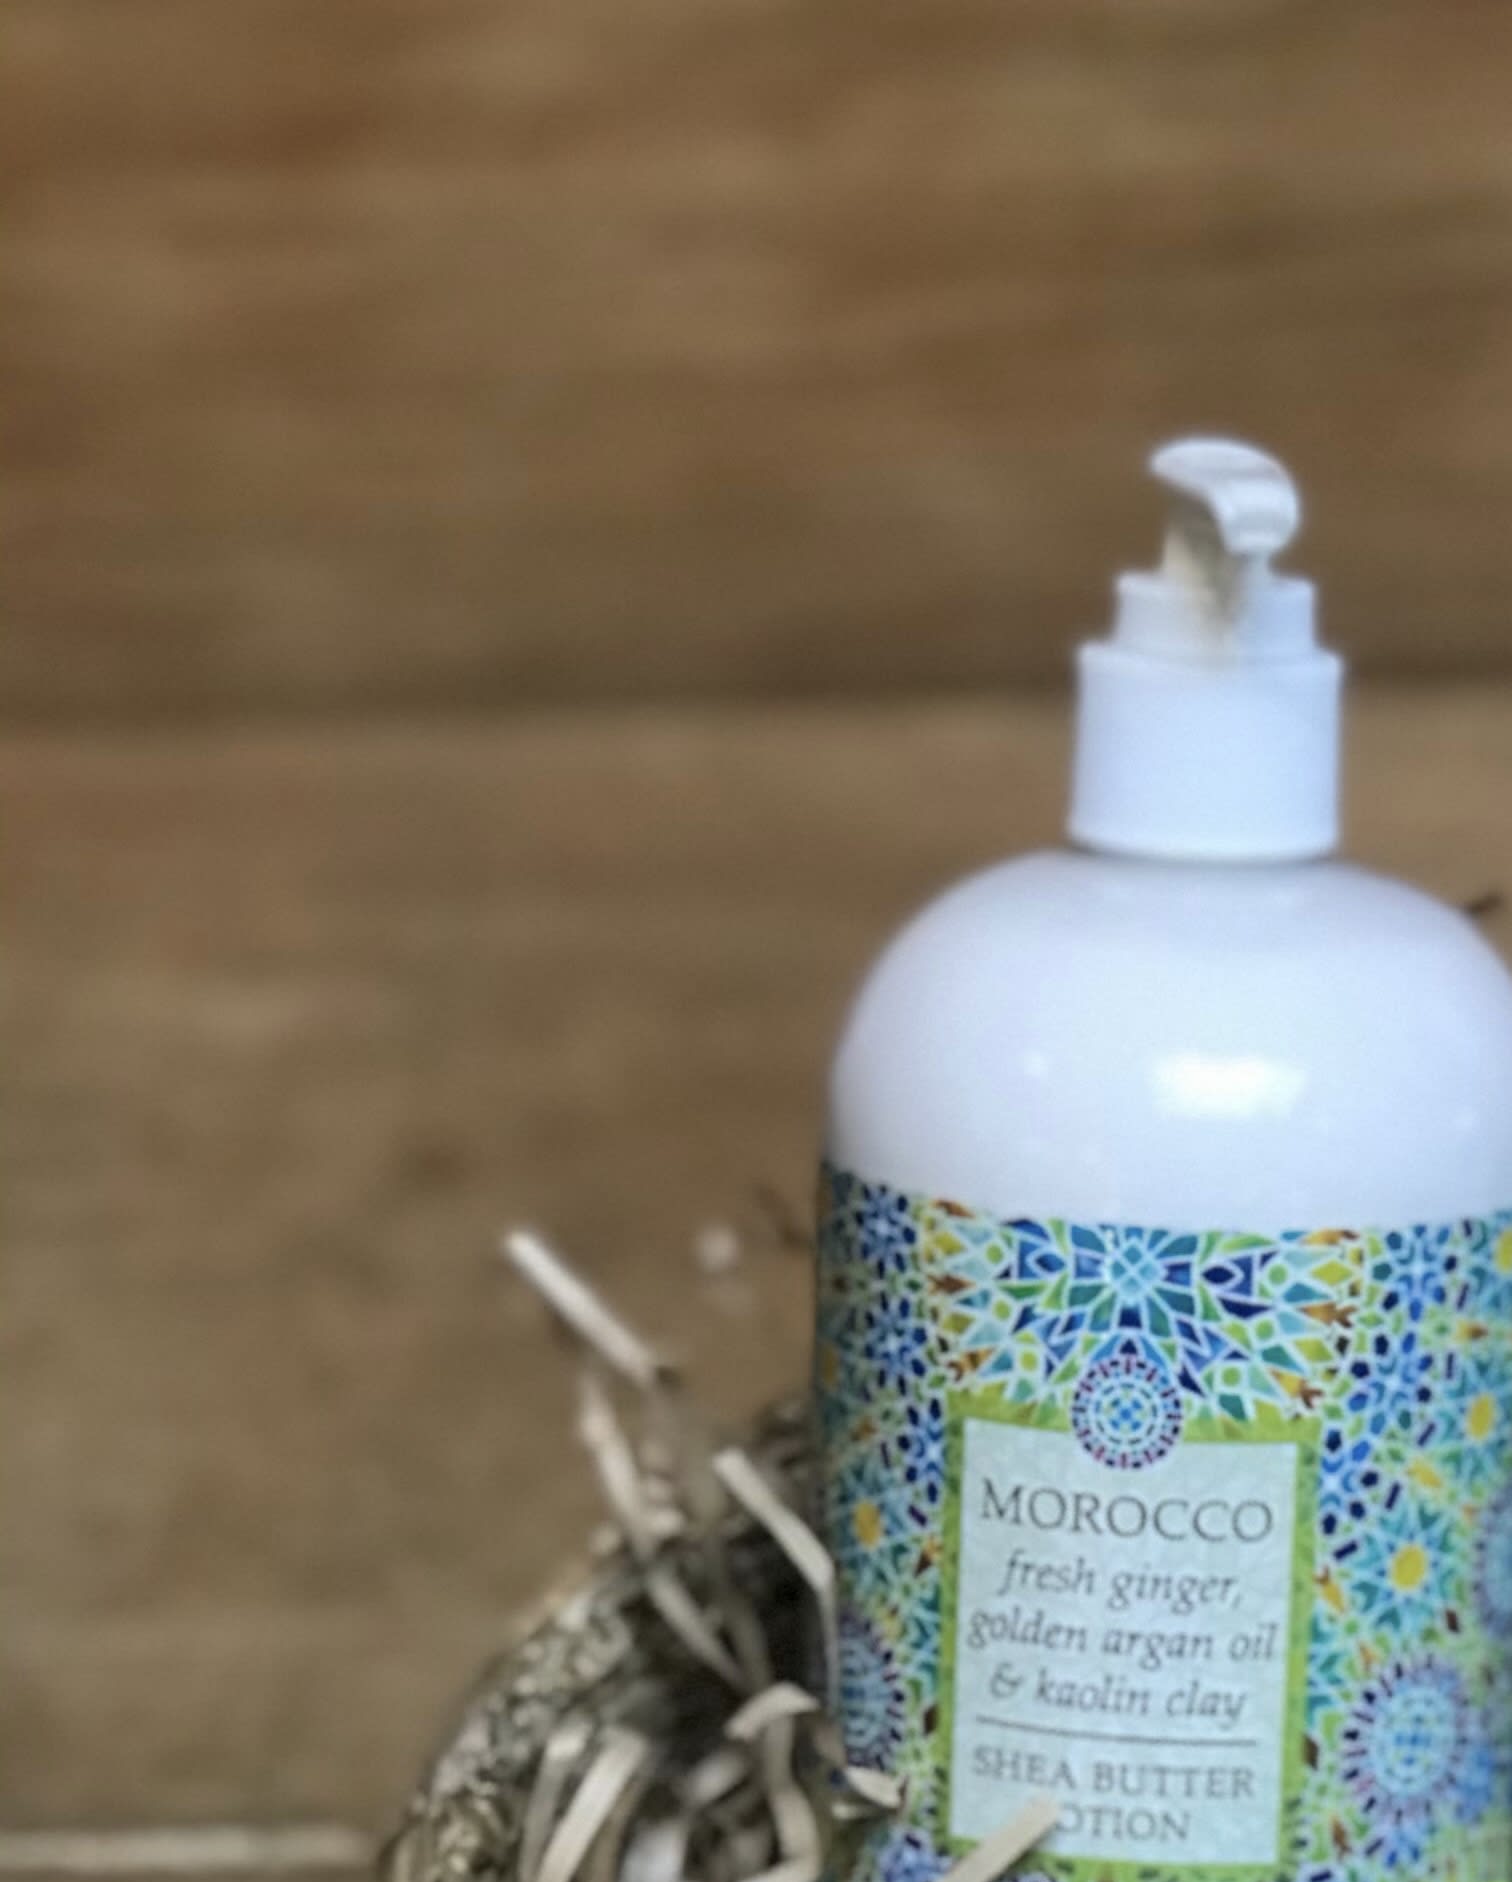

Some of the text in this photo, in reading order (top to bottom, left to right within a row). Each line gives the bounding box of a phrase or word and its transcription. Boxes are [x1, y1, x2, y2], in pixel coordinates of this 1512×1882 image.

[980, 1478, 1273, 1543] MOROCCO
[997, 1549, 1241, 1615] fresh ginger,
[966, 1607, 1279, 1671] golden argan oil
[989, 1662, 1247, 1730] & kaolin clay
[973, 1745, 1256, 1799] SHEA BUTTER
[1052, 1802, 1191, 1843] OTION
